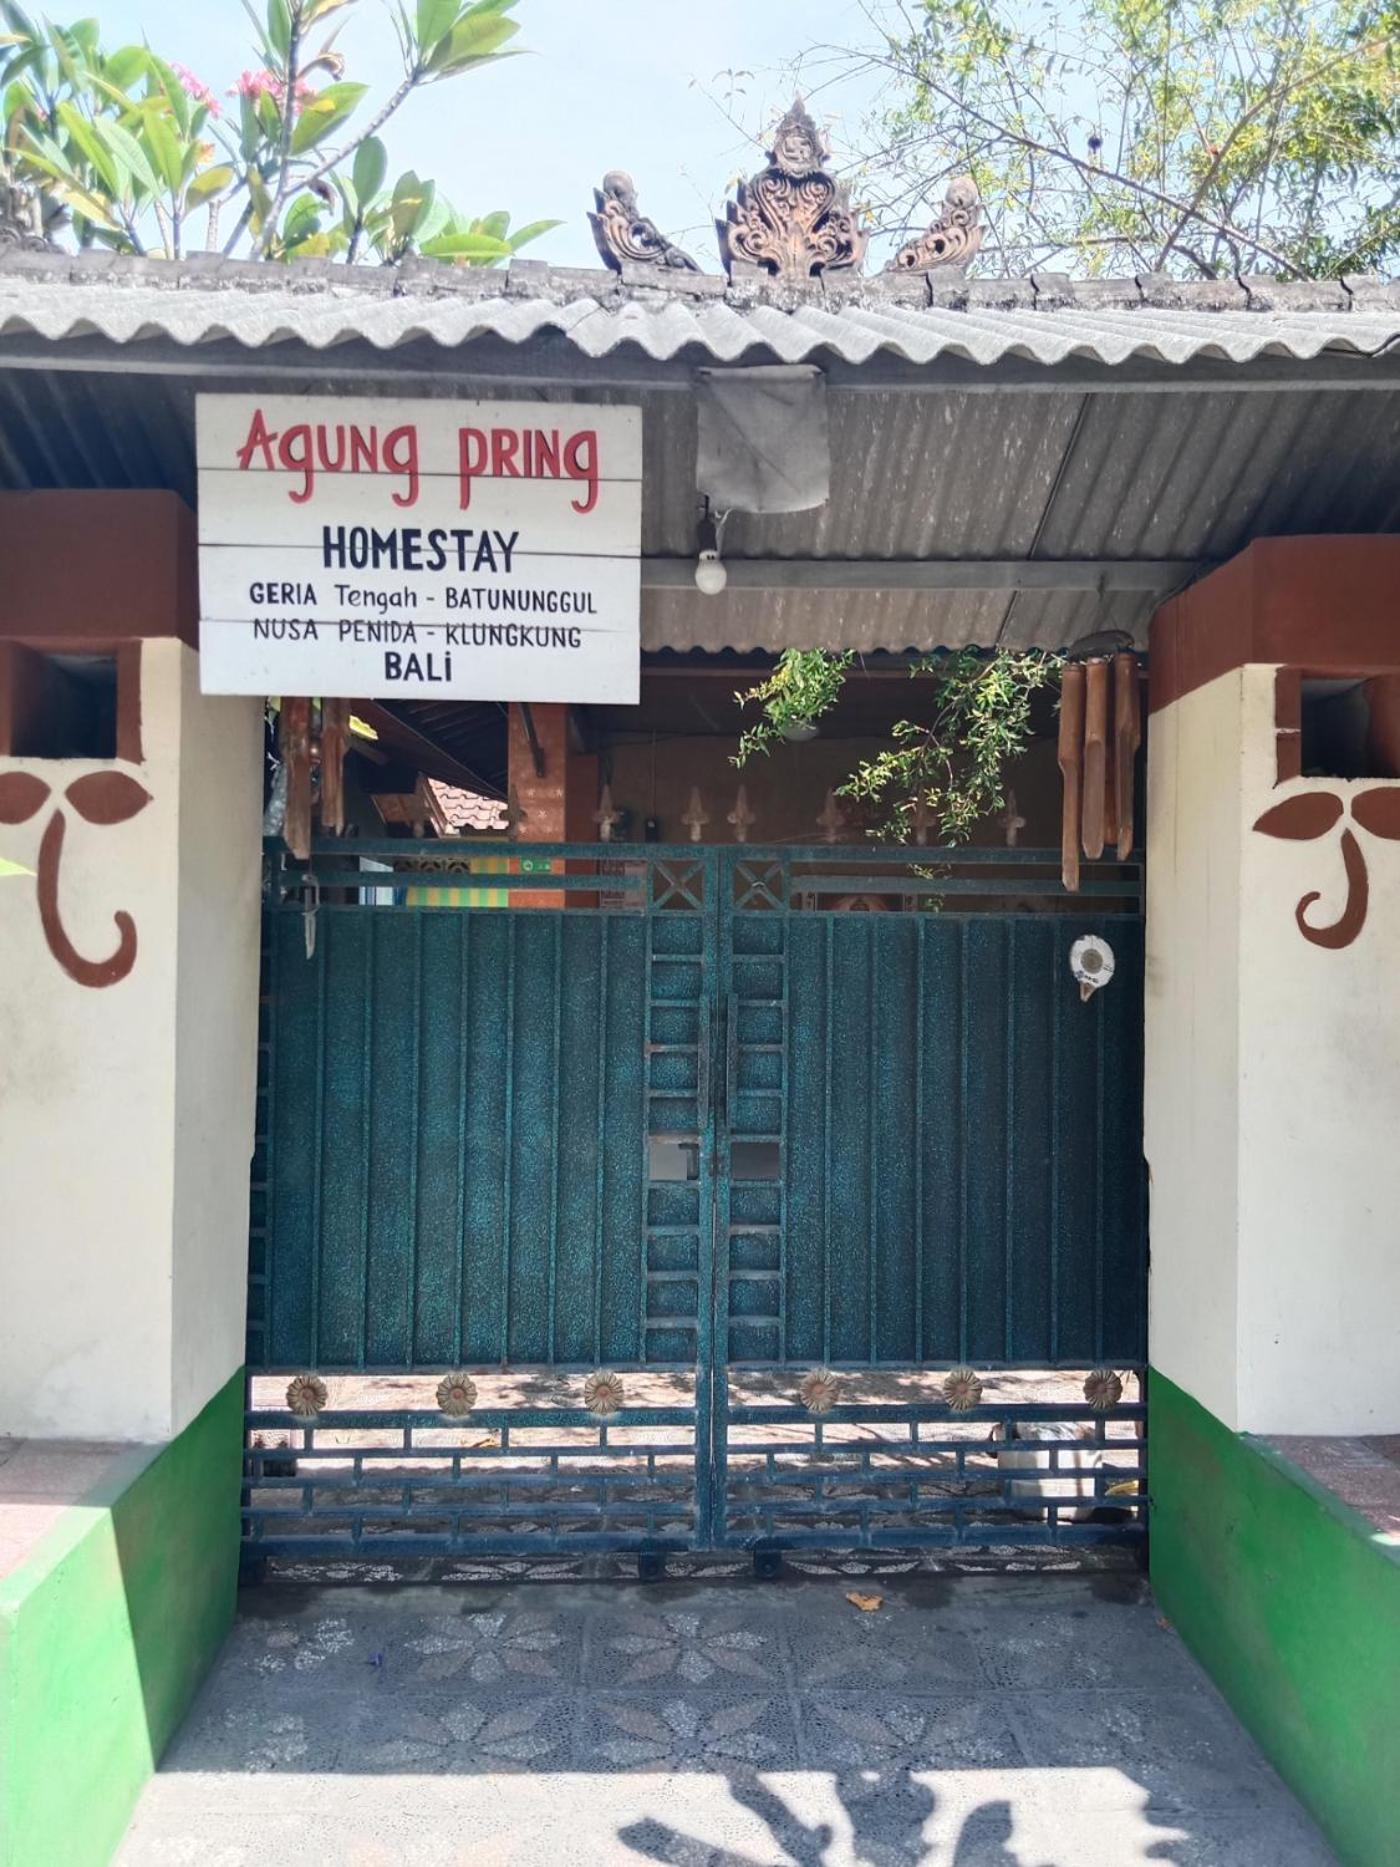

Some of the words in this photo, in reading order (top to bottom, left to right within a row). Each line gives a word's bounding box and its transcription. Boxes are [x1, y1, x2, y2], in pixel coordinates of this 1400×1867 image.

[322, 526, 519, 573] HOMESTAY
[249, 582, 317, 606] GERIA
[334, 584, 417, 614] Tengah
[446, 587, 597, 614] BATUNUNGGUL
[253, 618, 319, 641] NUSA
[339, 620, 417, 643] PENIDA
[446, 623, 582, 648] KLUNGKUNG
